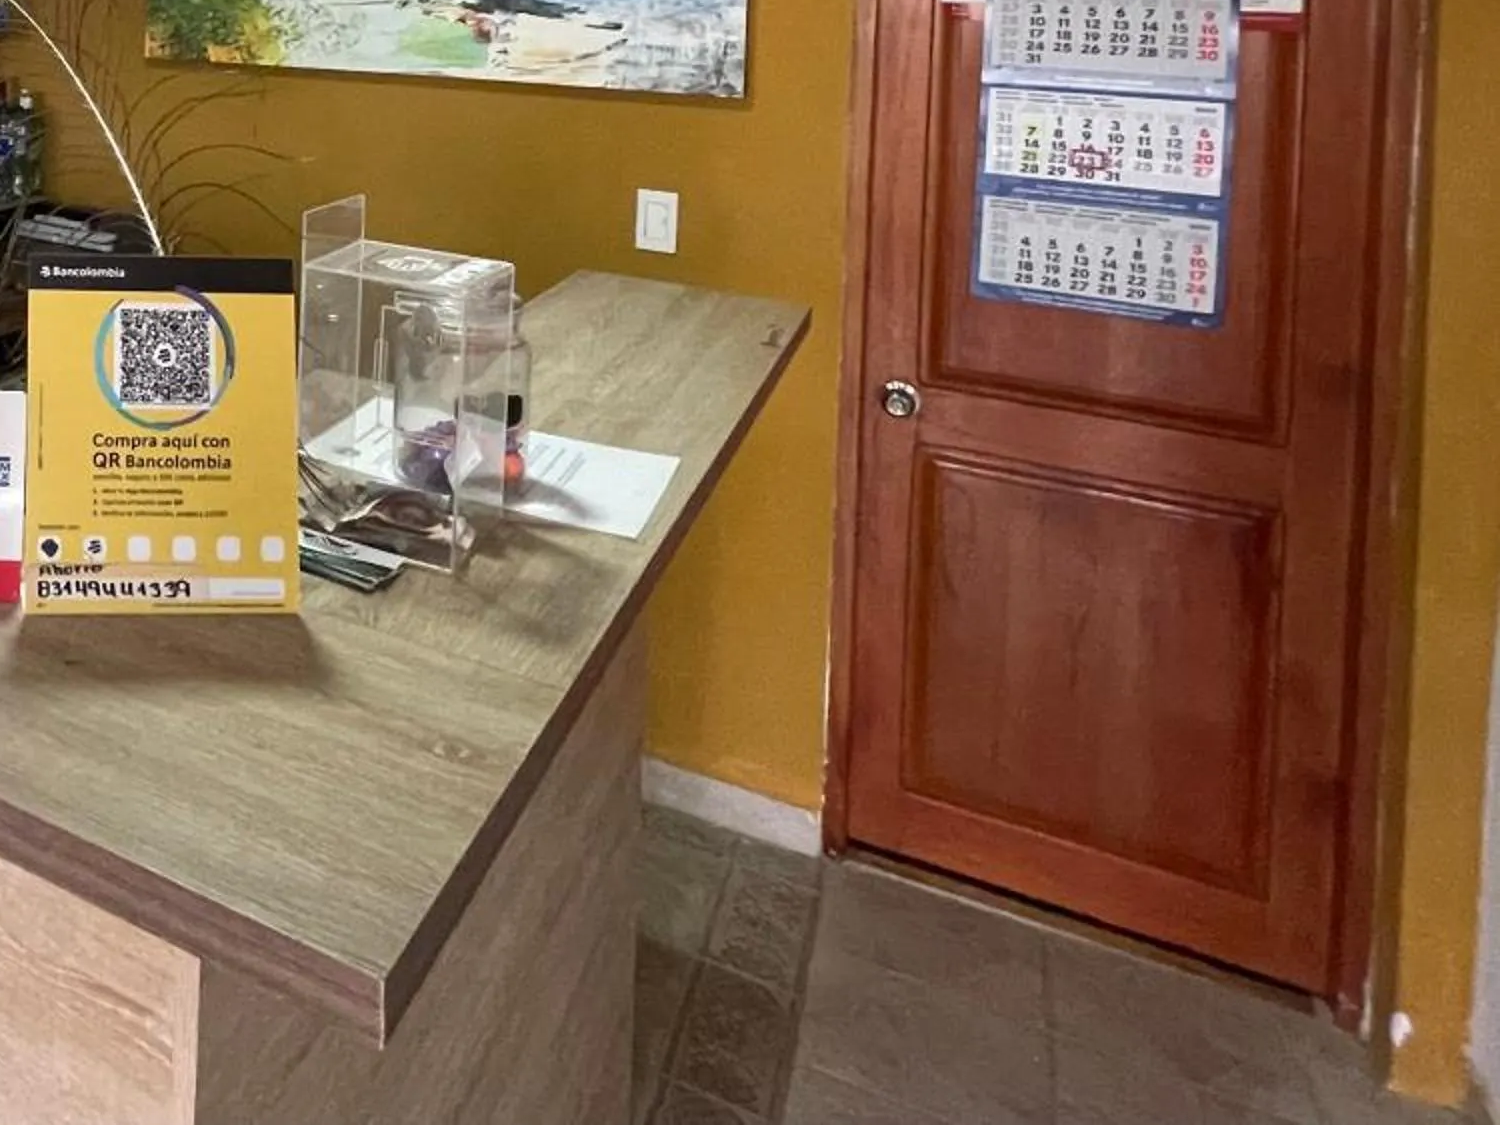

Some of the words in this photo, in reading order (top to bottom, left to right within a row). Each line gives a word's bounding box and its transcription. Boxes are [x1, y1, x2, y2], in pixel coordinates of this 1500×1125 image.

[1033, 4, 1041, 13] 3
[1060, 6, 1069, 14] 4
[1088, 7, 1097, 17] 5
[1116, 8, 1125, 18] 6
[1146, 9, 1155, 18] 7
[1057, 116, 1062, 126] 1
[1083, 119, 1092, 129] 2
[1112, 121, 1120, 131] 3
[1140, 123, 1150, 133] 4
[1028, 127, 1037, 135] 7
[1054, 129, 1063, 138] 8
[1082, 131, 1091, 140] 9
[1021, 237, 1030, 246] 4
[1049, 239, 1057, 249] 5
[1076, 243, 1085, 253] 6
[1105, 247, 1114, 256] 7
[1137, 238, 1142, 247] 1
[53, 266, 125, 279] Bancolombia
[92, 433, 157, 451] Compra
[161, 433, 198, 451] aquí
[202, 435, 230, 448] con
[93, 452, 120, 470] QR
[125, 454, 232, 470] Bancolombia
